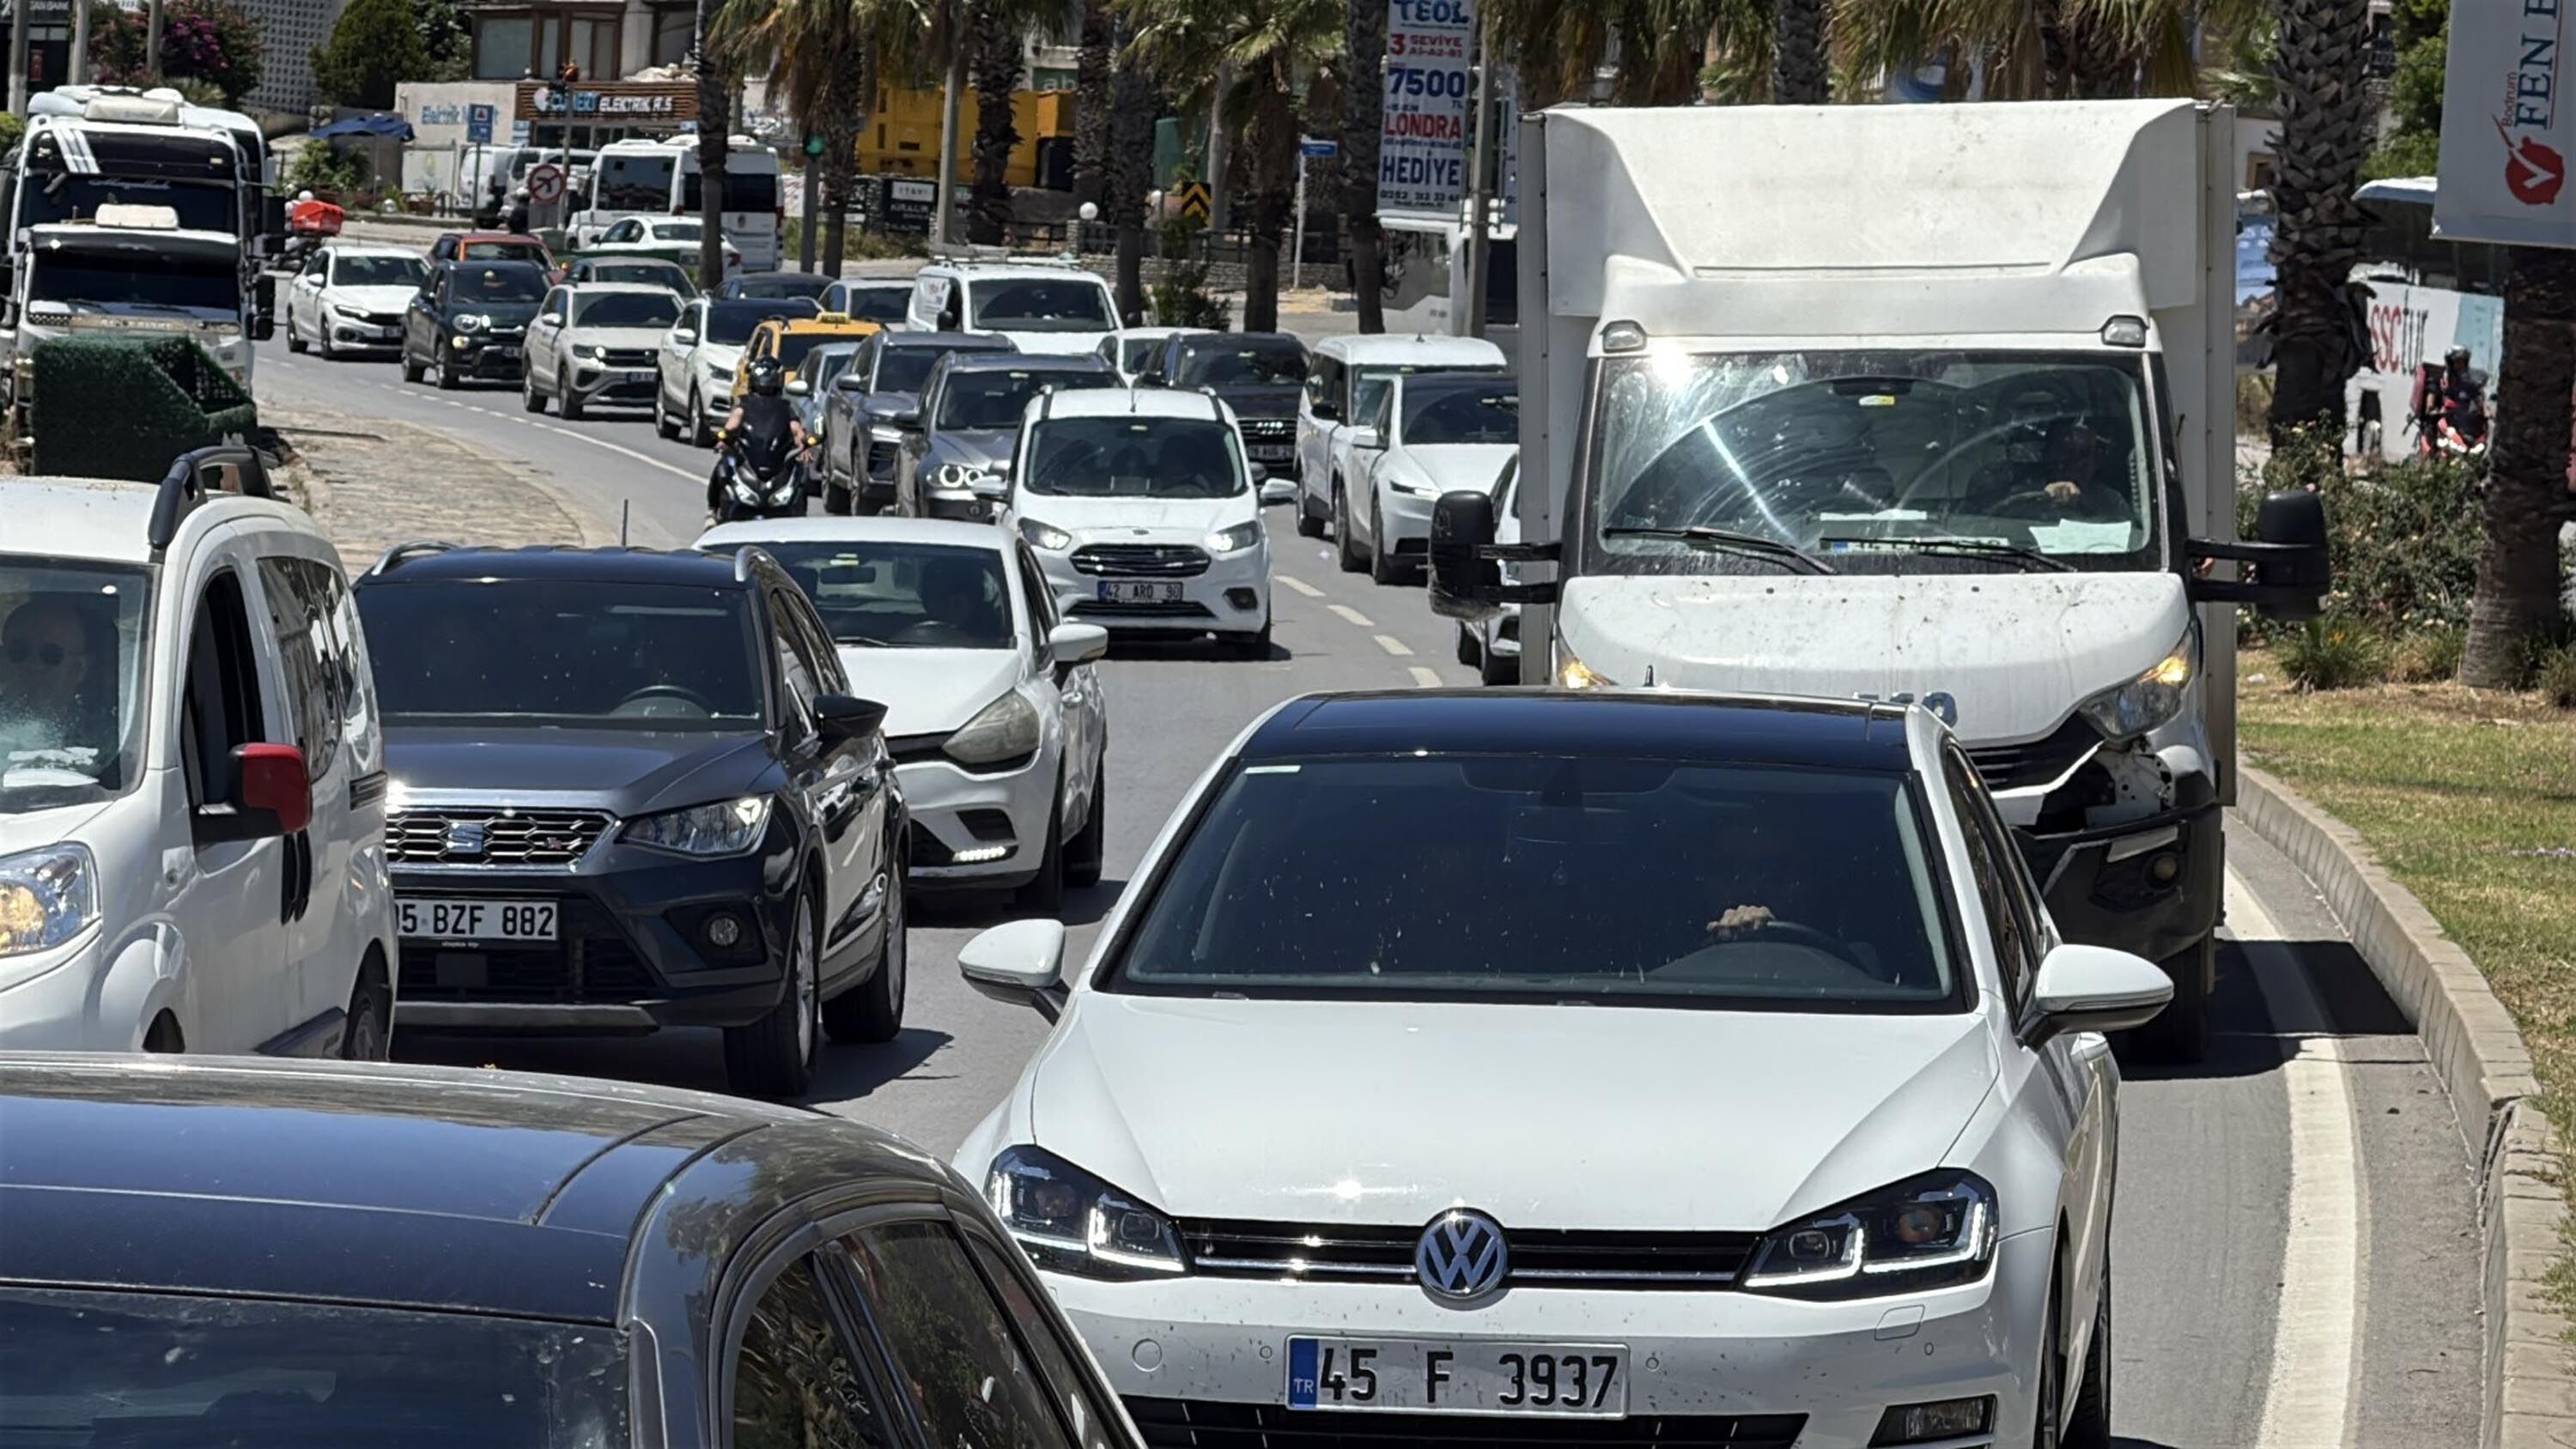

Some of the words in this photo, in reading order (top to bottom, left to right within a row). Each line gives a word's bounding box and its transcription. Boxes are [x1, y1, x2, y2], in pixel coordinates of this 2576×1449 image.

[1393, 0, 1470, 24] TEOL
[1389, 33, 1406, 56] 3
[1409, 34, 1462, 47] SEVİYE
[1388, 68, 1466, 98] 7500
[2513, 33, 2555, 130] FEN
[2500, 71, 2518, 127] Bodrum
[1384, 113, 1461, 140] LONDRA
[1381, 150, 1461, 186] HEDİYE
[434, 904, 485, 935] BZF
[501, 906, 554, 937] 882
[1294, 1378, 1314, 1395] TR
[1320, 1348, 1377, 1401] 45
[1426, 1350, 1454, 1404] F
[1498, 1353, 1619, 1408] 3937
